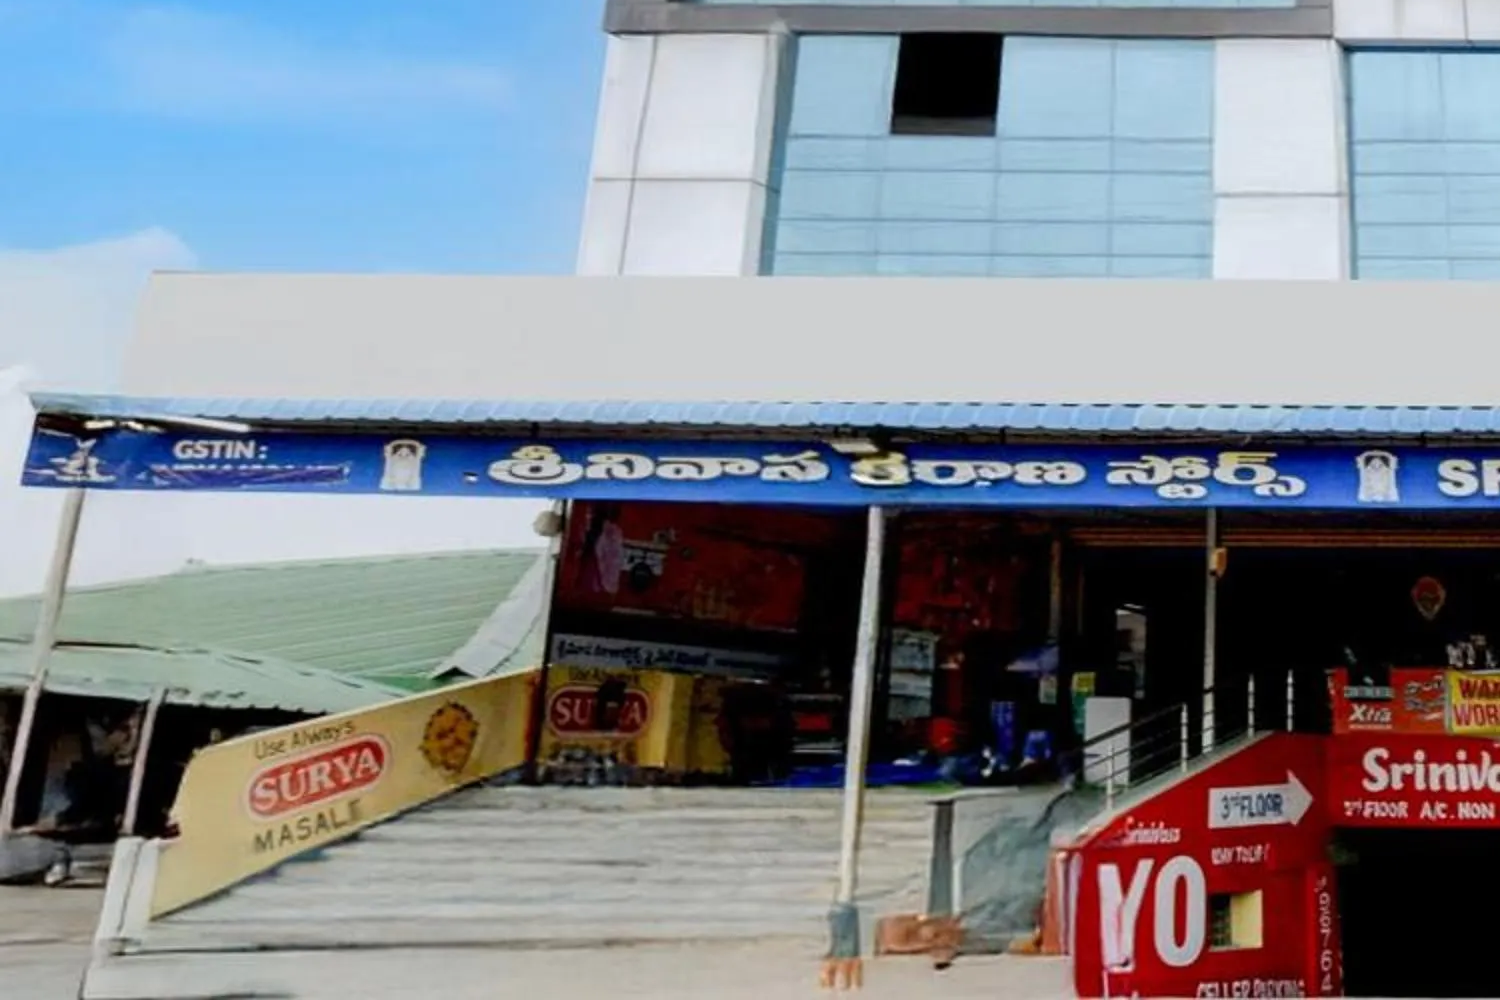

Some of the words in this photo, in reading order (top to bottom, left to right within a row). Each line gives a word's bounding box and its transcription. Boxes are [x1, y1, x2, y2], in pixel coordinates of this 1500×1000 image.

[554, 697, 642, 724] SUA
[254, 740, 285, 759] Use
[291, 720, 355, 747] Always
[252, 747, 381, 811] SURYA
[1458, 802, 1495, 820] NON
